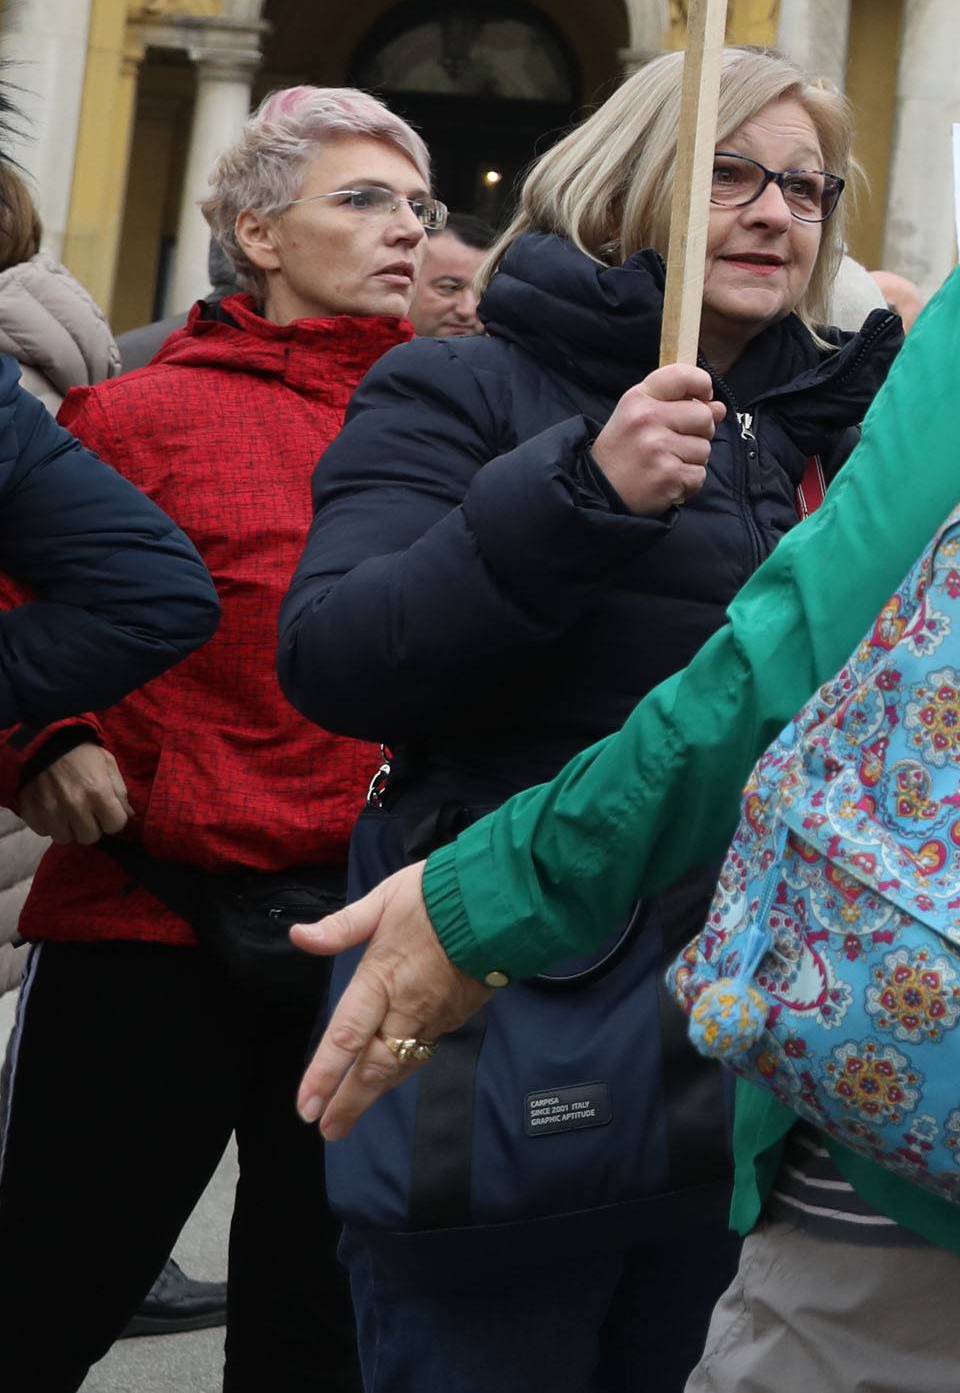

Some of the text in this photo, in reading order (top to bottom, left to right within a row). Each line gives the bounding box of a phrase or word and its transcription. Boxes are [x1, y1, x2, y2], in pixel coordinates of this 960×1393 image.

[530, 1097, 559, 1108] CARPISA
[530, 1100, 590, 1117] SINCE 2001 ITALY
[531, 1108, 595, 1126] GRAPHIC APTITUDE
